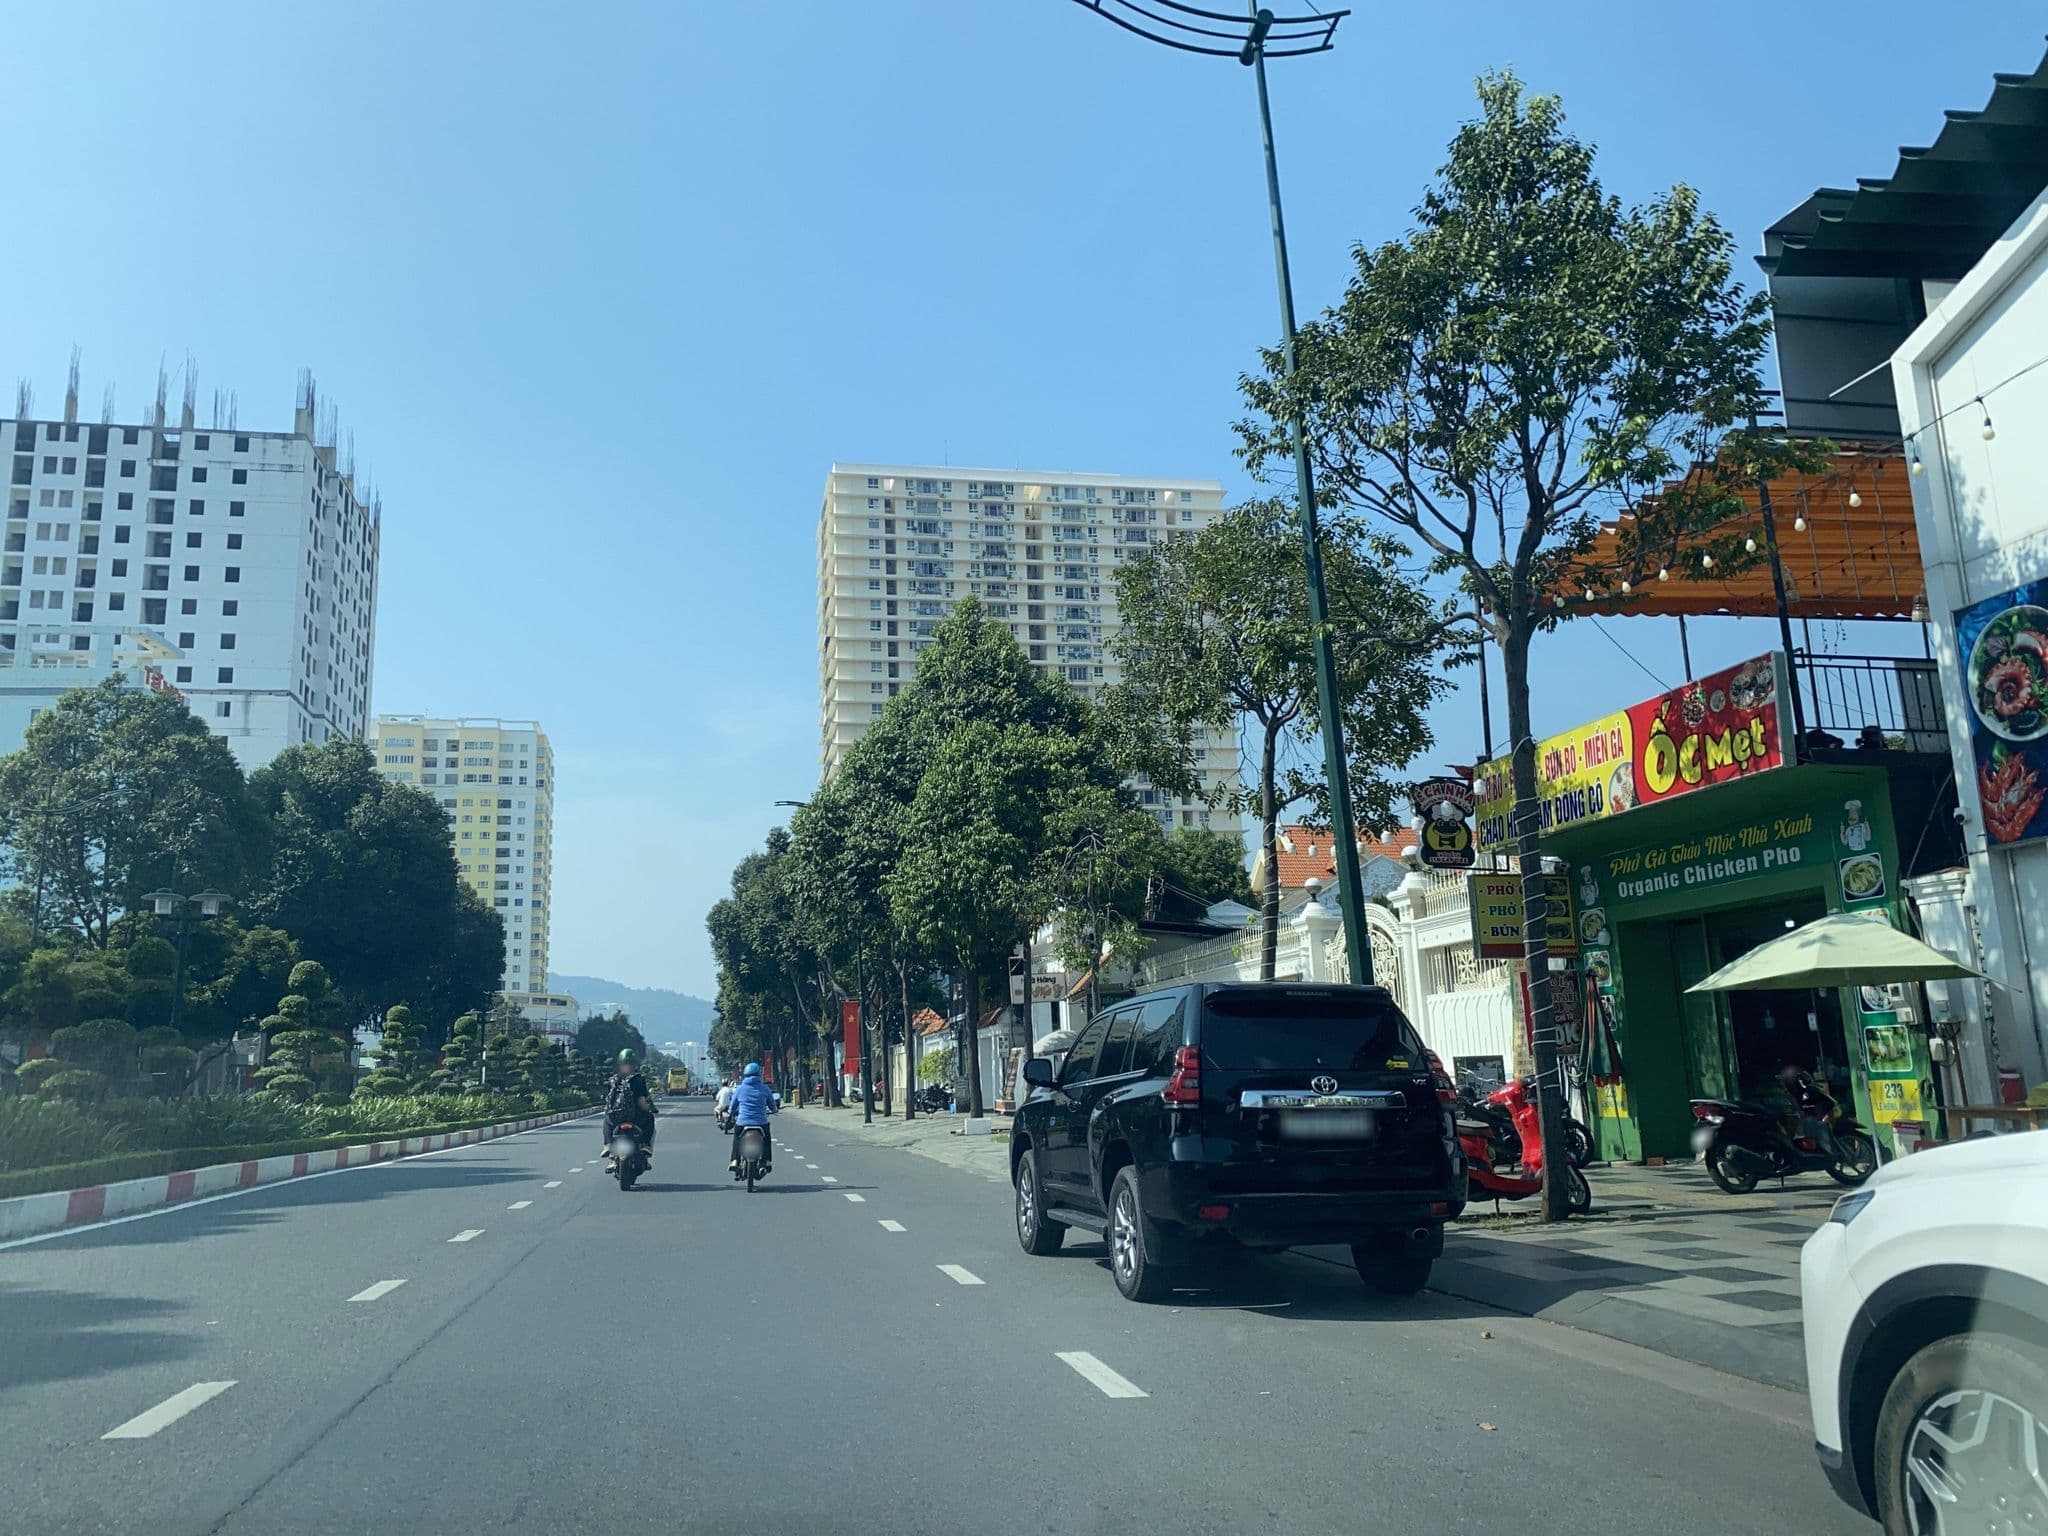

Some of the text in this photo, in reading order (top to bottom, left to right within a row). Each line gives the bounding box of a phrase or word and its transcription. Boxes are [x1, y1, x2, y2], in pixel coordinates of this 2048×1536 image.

[1564, 738, 1577, 776] BÒ
[1583, 726, 1609, 768] MIẾN
[1610, 722, 1625, 762] GÀ
[1643, 700, 1766, 794] ỐC Mẹt
[1480, 811, 1505, 847] CHÁO
[1555, 789, 1586, 824] ĐÔNG
[1588, 777, 1604, 815] CÔ
[1609, 814, 1812, 877] Phở Gà Thảo Mộc Nhà Xanh
[1618, 847, 1801, 898] Organic Chicken Pho
[1490, 924, 1519, 937] BÚN
[1884, 1083, 1904, 1099] 233
